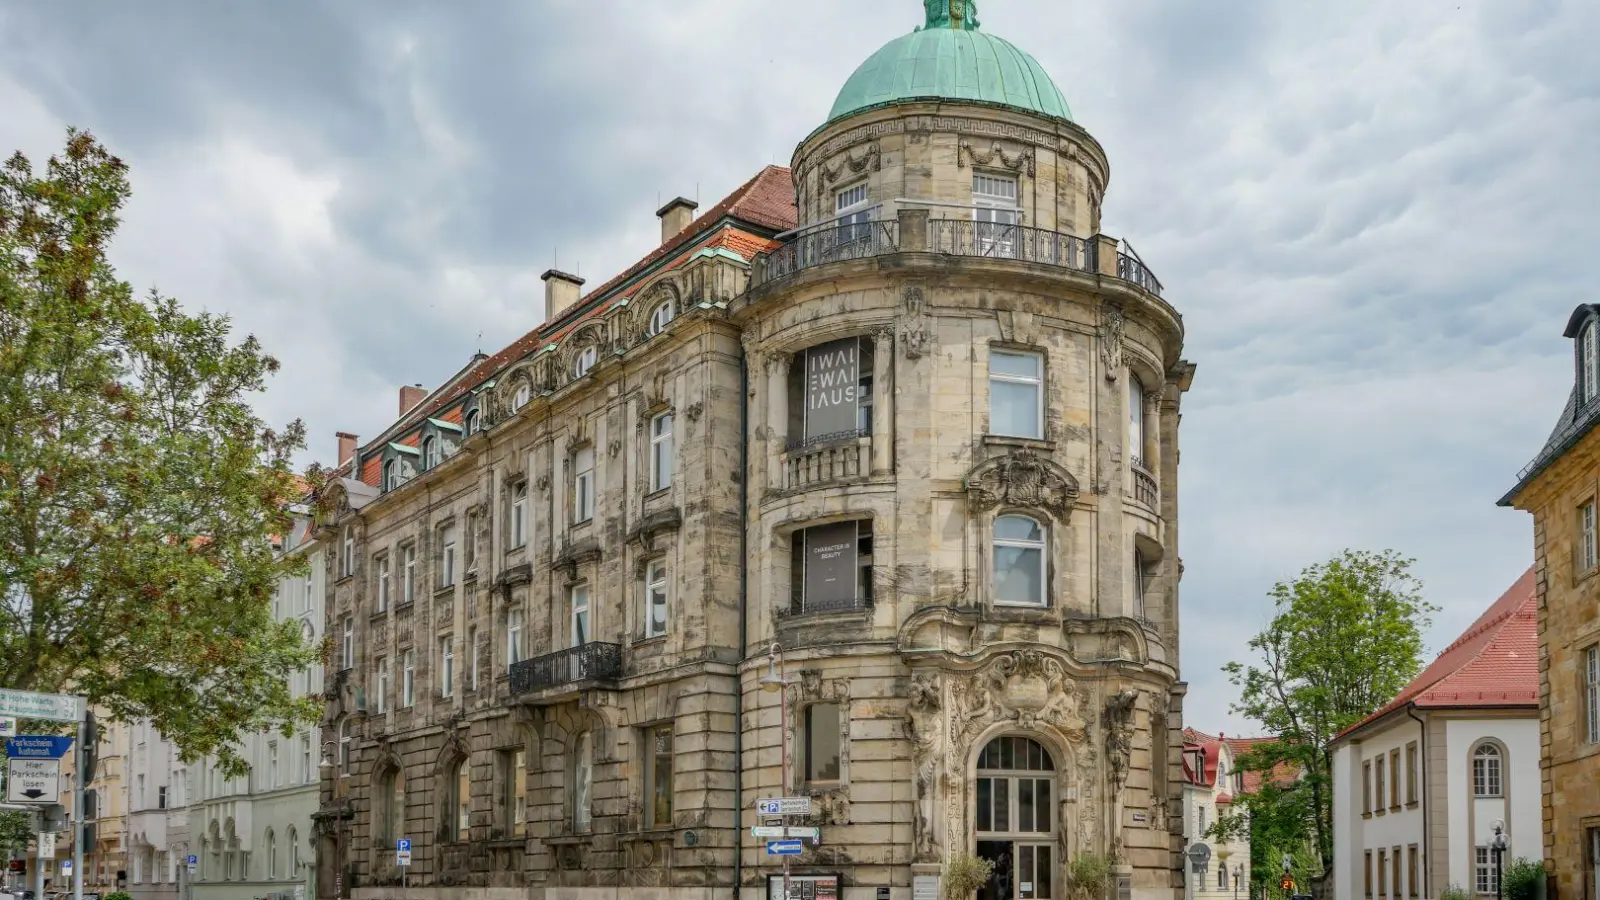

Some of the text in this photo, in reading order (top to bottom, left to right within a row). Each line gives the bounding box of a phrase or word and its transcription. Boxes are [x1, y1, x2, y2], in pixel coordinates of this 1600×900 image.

[8, 694, 29, 704] Hohe
[31, 696, 54, 705] Warte
[9, 738, 53, 748] Parkschein
[17, 747, 51, 756] Automat
[25, 761, 44, 769] Hier
[11, 770, 57, 779] Parkschein
